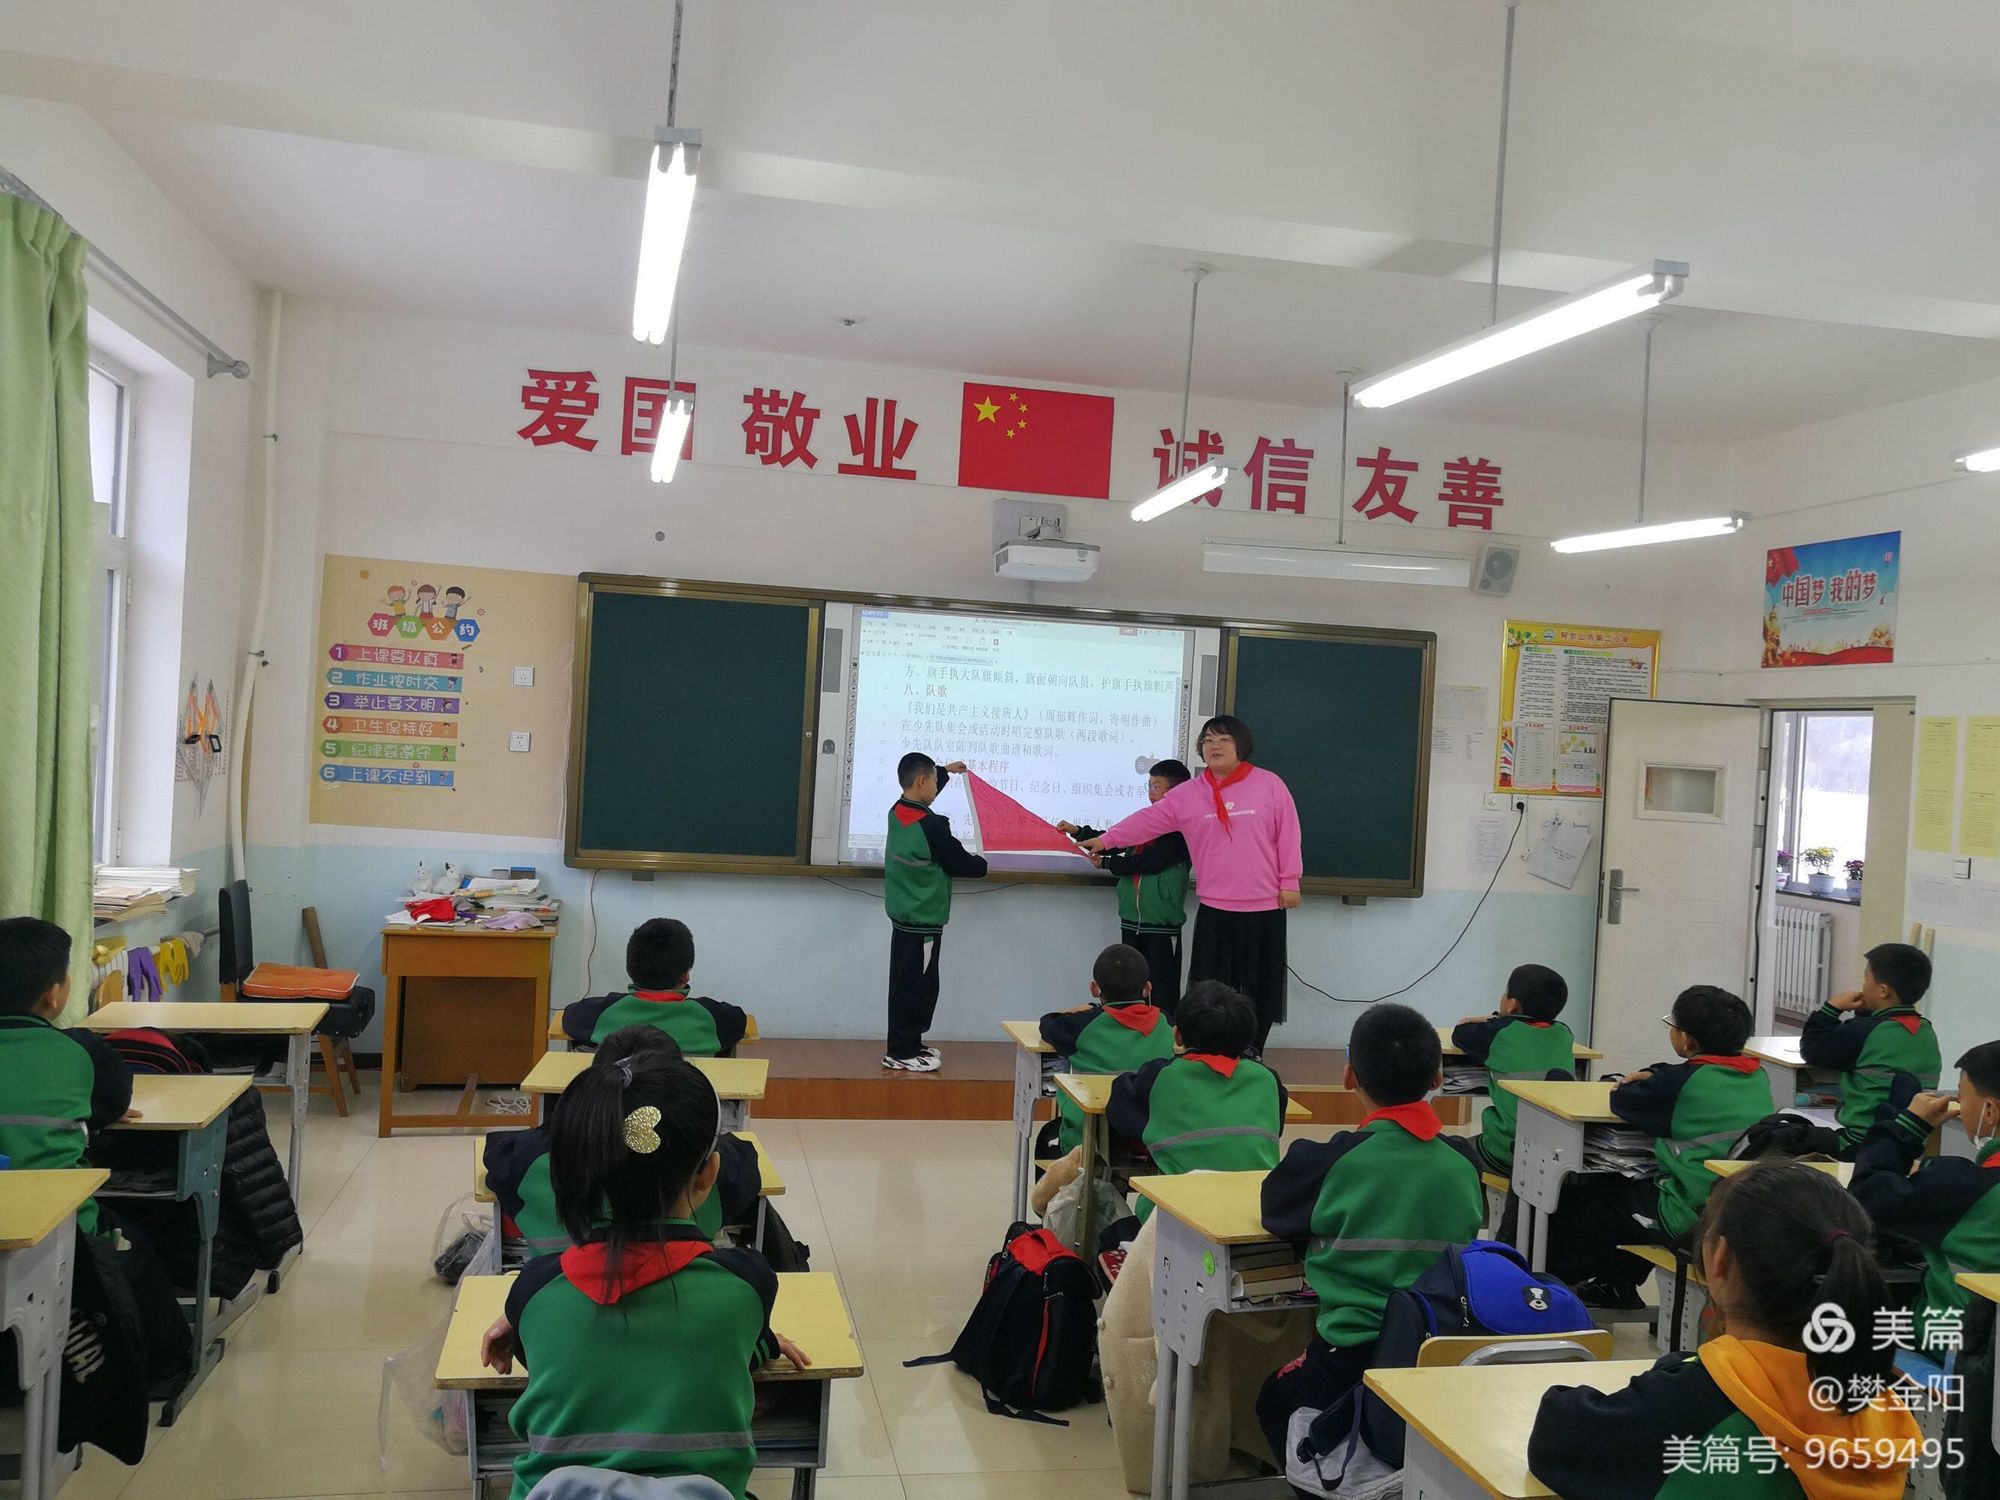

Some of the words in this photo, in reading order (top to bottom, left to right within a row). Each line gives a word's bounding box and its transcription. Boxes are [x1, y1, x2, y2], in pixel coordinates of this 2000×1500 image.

[517, 368, 697, 461] 爱国
[741, 387, 919, 481] 敬业
[1153, 428, 1315, 515] 诚信
[1351, 446, 1505, 531] 友善
[1782, 575, 1826, 607] 中国梦
[1830, 569, 1878, 603] 我的梦
[373, 619, 476, 637] 班级公约
[356, 647, 439, 668] 上课要认真
[331, 671, 343, 683] 2
[355, 671, 439, 690] 作业按时交
[328, 694, 340, 706] 3
[354, 694, 436, 711] 举止要文明
[326, 718, 339, 730] 4
[353, 719, 434, 736] 卫生保持好
[325, 742, 337, 754] 5
[351, 743, 432, 760] 纪律要遵守
[323, 767, 336, 778] 6
[347, 767, 431, 785] 上课不迟到
